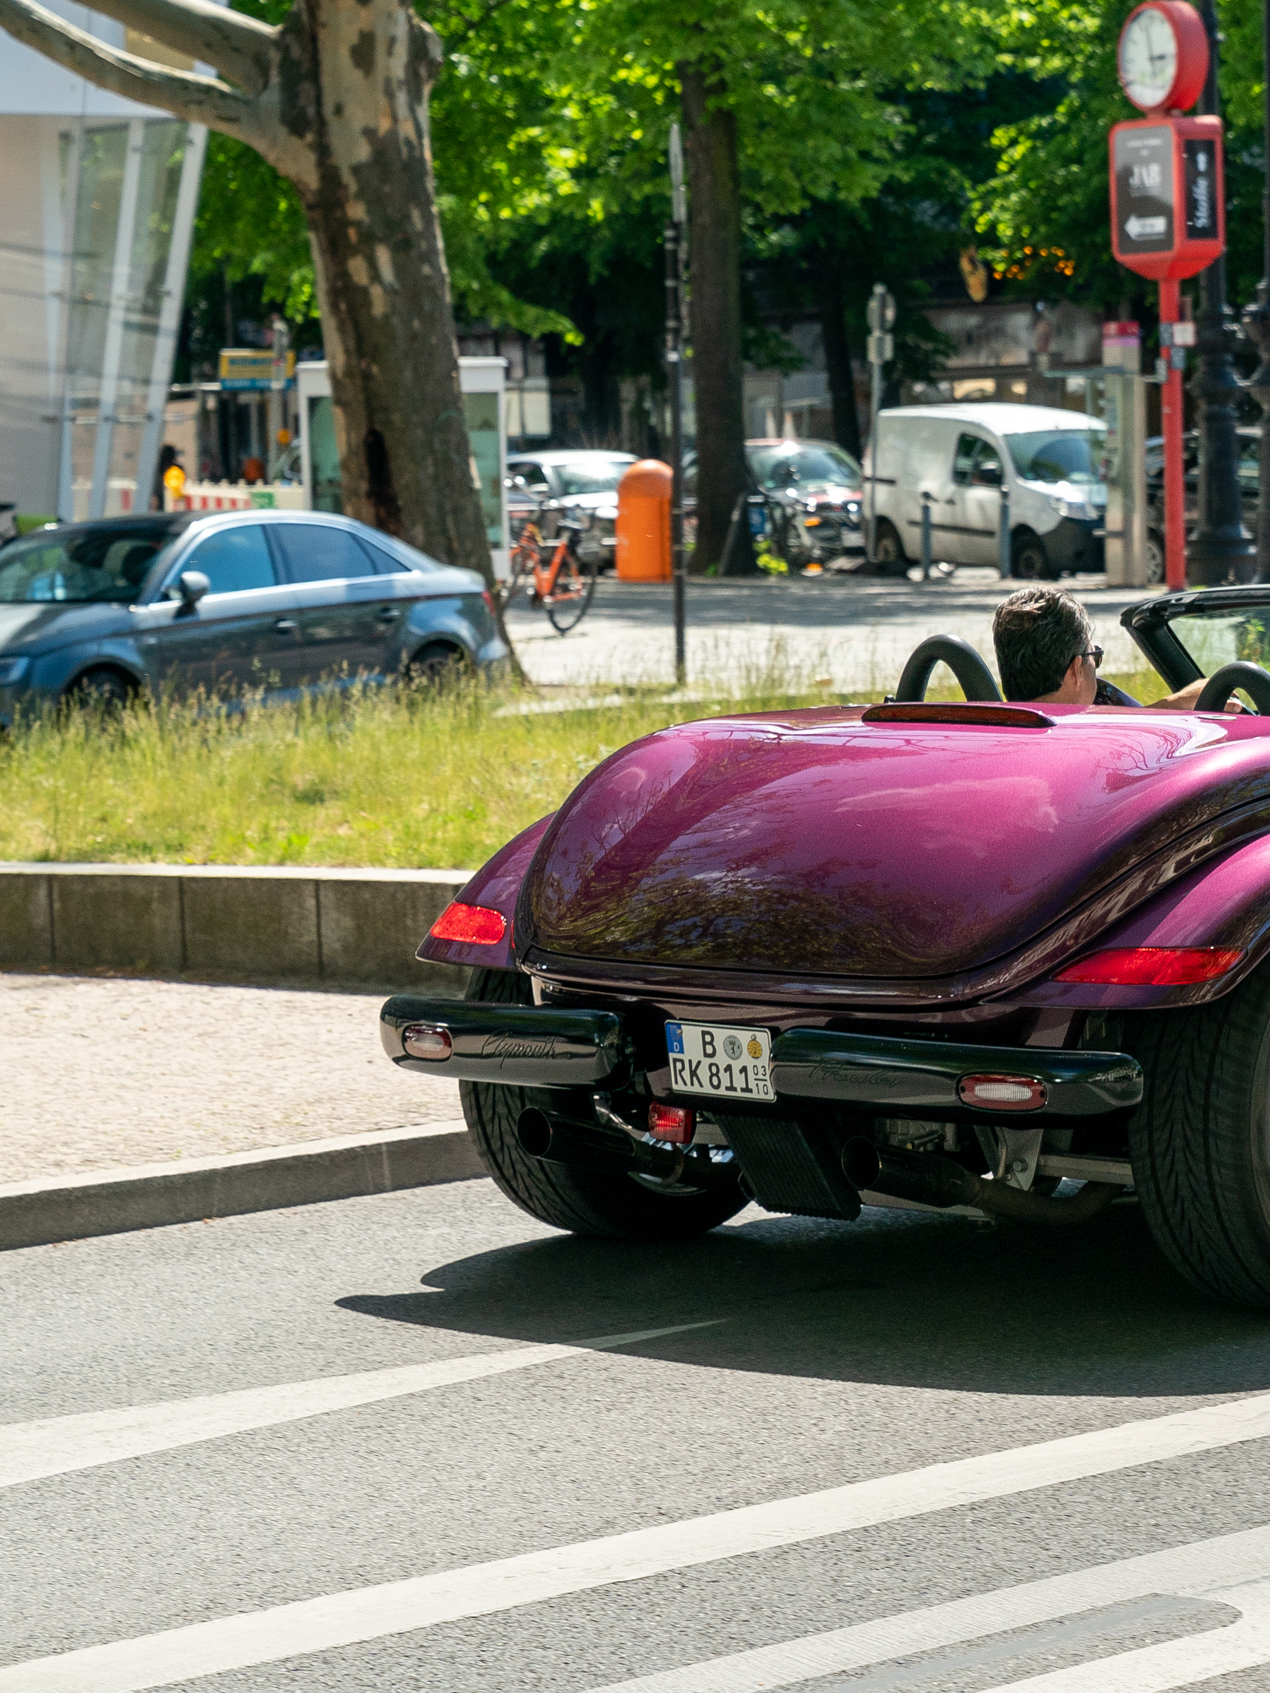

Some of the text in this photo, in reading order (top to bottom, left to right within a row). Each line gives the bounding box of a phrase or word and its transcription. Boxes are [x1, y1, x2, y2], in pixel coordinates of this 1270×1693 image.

[481, 1029, 560, 1069] Plymouth
[673, 1042, 680, 1052] D
[701, 1030, 717, 1058] B
[753, 1064, 767, 1077] 03
[755, 1082, 769, 1095] 10
